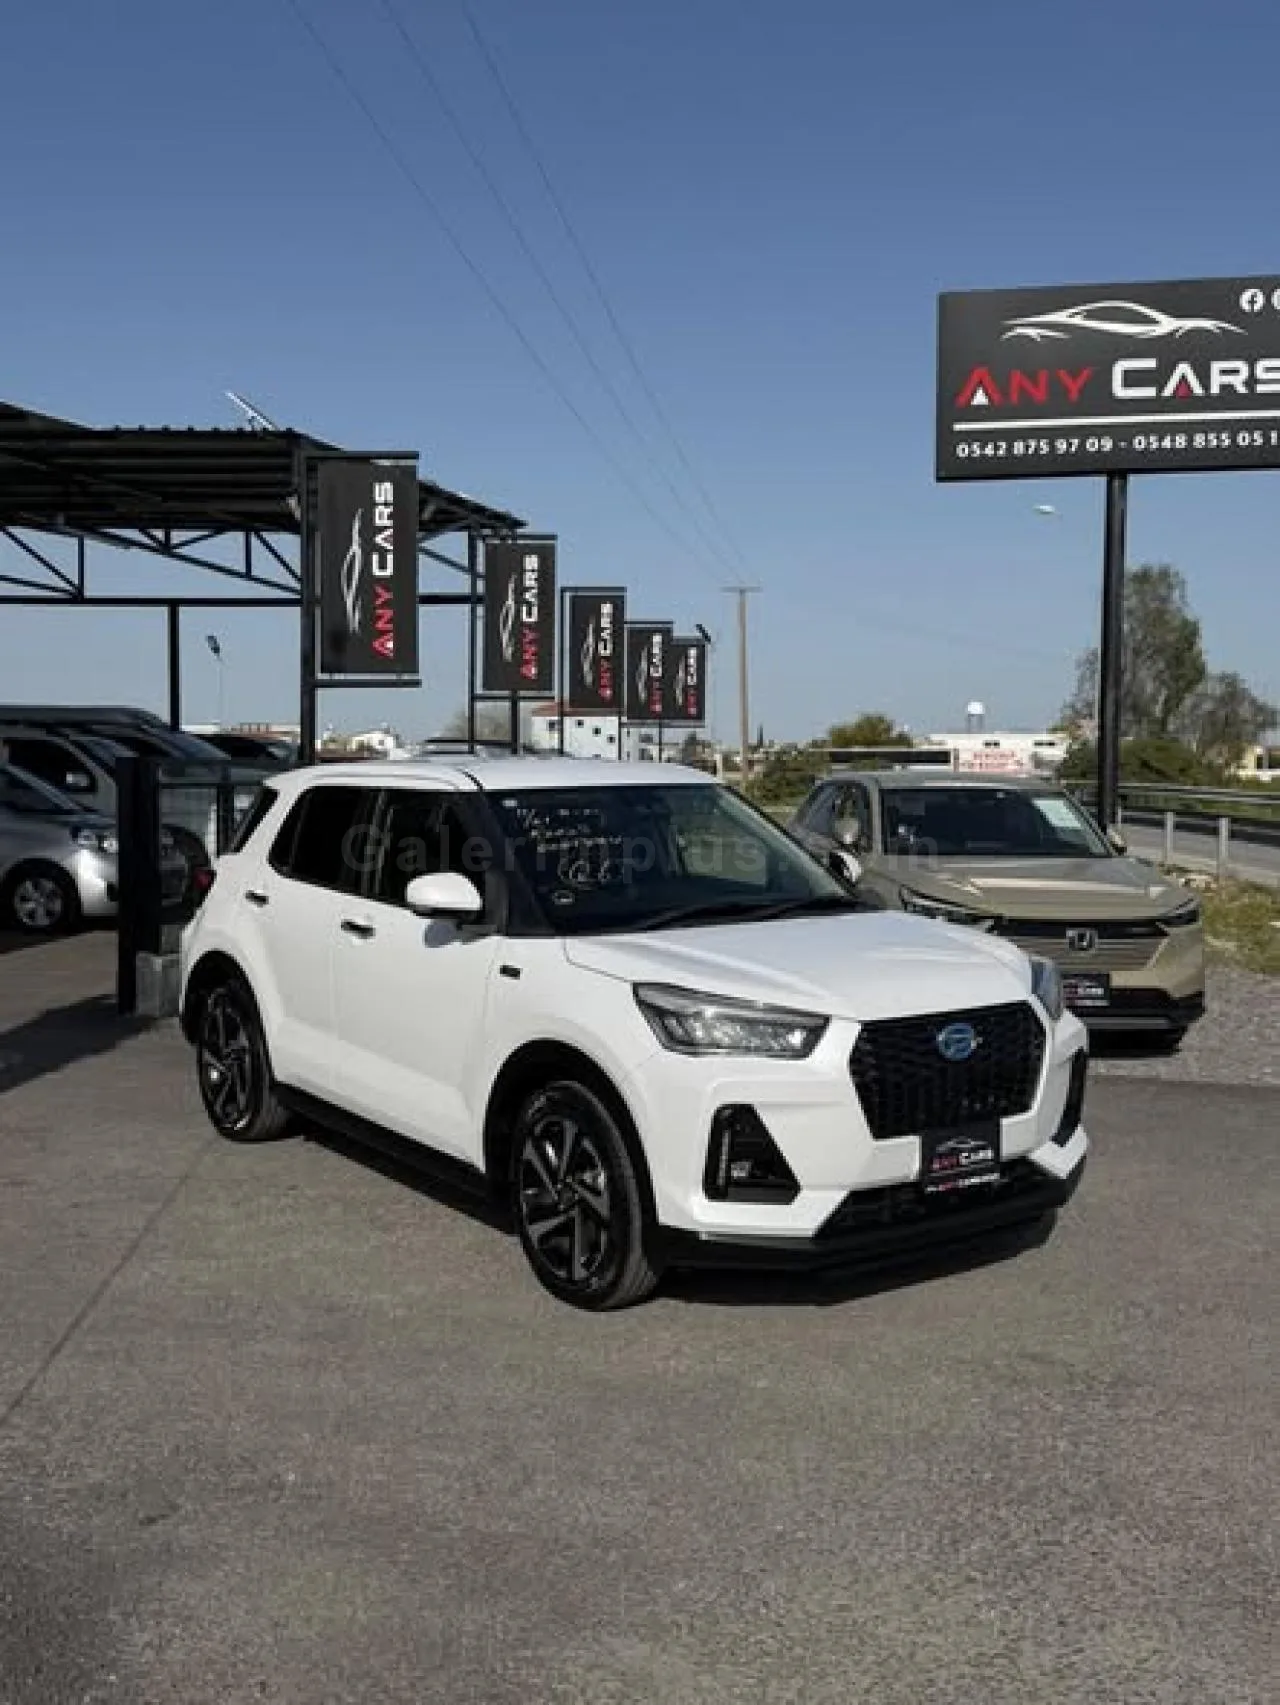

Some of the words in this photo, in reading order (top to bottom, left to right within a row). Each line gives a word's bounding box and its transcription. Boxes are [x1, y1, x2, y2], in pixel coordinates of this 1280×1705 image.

[956, 364, 1094, 408] ANY
[1112, 357, 1280, 399] CARS
[372, 481, 394, 576] CARS
[372, 583, 394, 658] ANY
[522, 554, 539, 622] CARS
